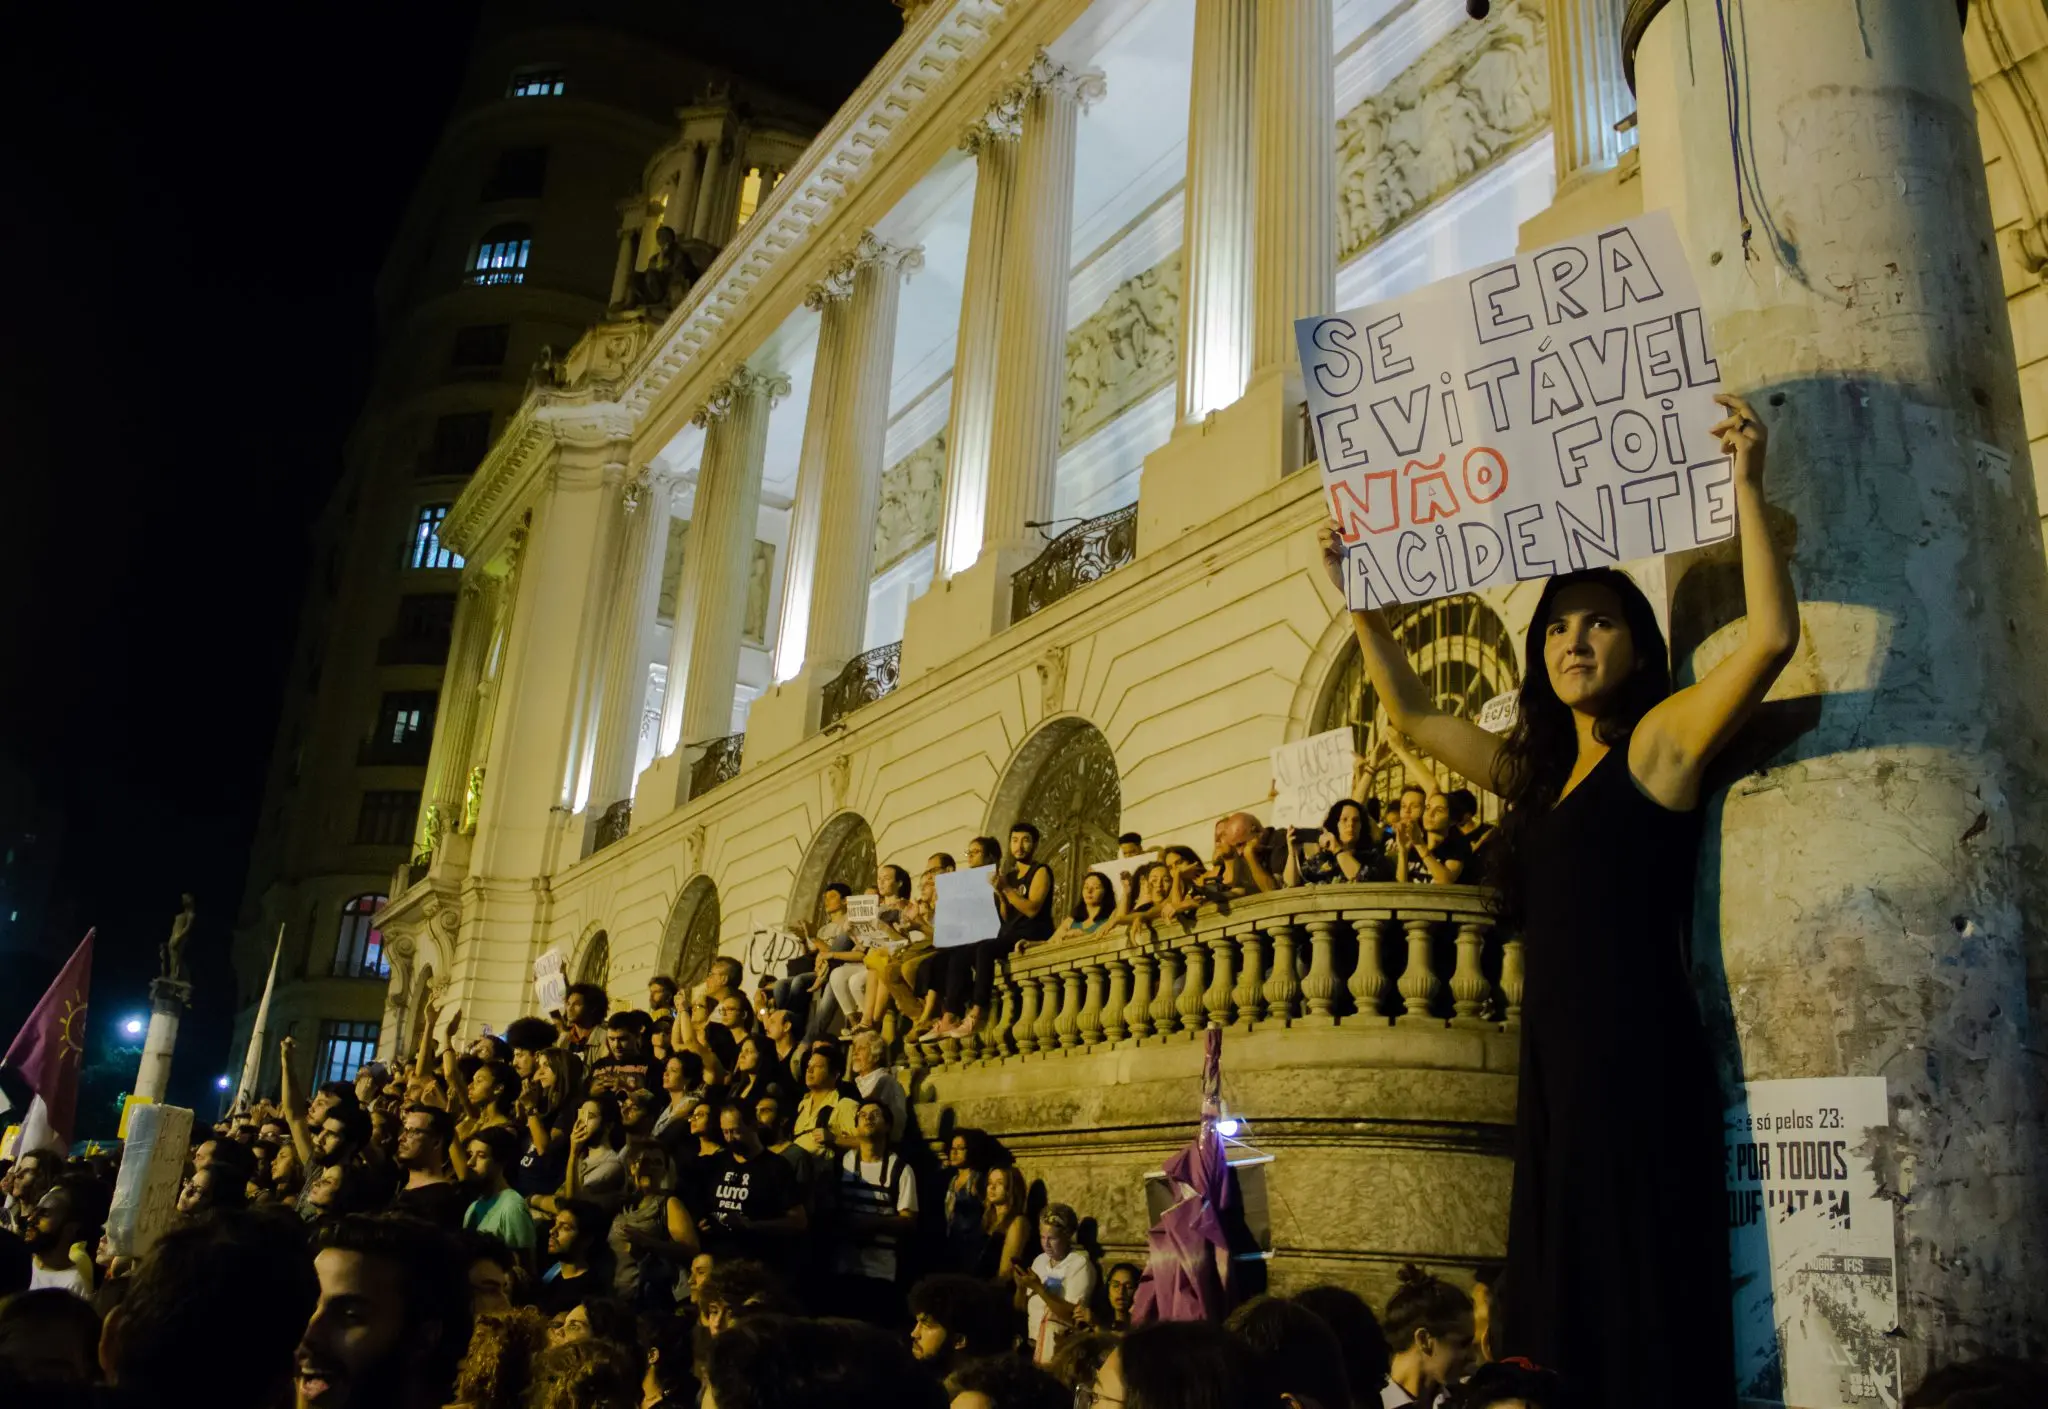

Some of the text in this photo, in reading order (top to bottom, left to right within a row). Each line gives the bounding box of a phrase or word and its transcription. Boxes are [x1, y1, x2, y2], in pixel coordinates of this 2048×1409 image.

[1313, 227, 1664, 397] SE ERA
[1330, 446, 1509, 542] NÃO
[1757, 1113, 1771, 1130] só
[1776, 1109, 1813, 1133] pelos
[1819, 1108, 1844, 1128] 23:
[1737, 1143, 1770, 1181] POR
[1777, 1141, 1848, 1180] TODOS
[716, 1184, 749, 1201] LUTO
[719, 1200, 742, 1211] PELA
